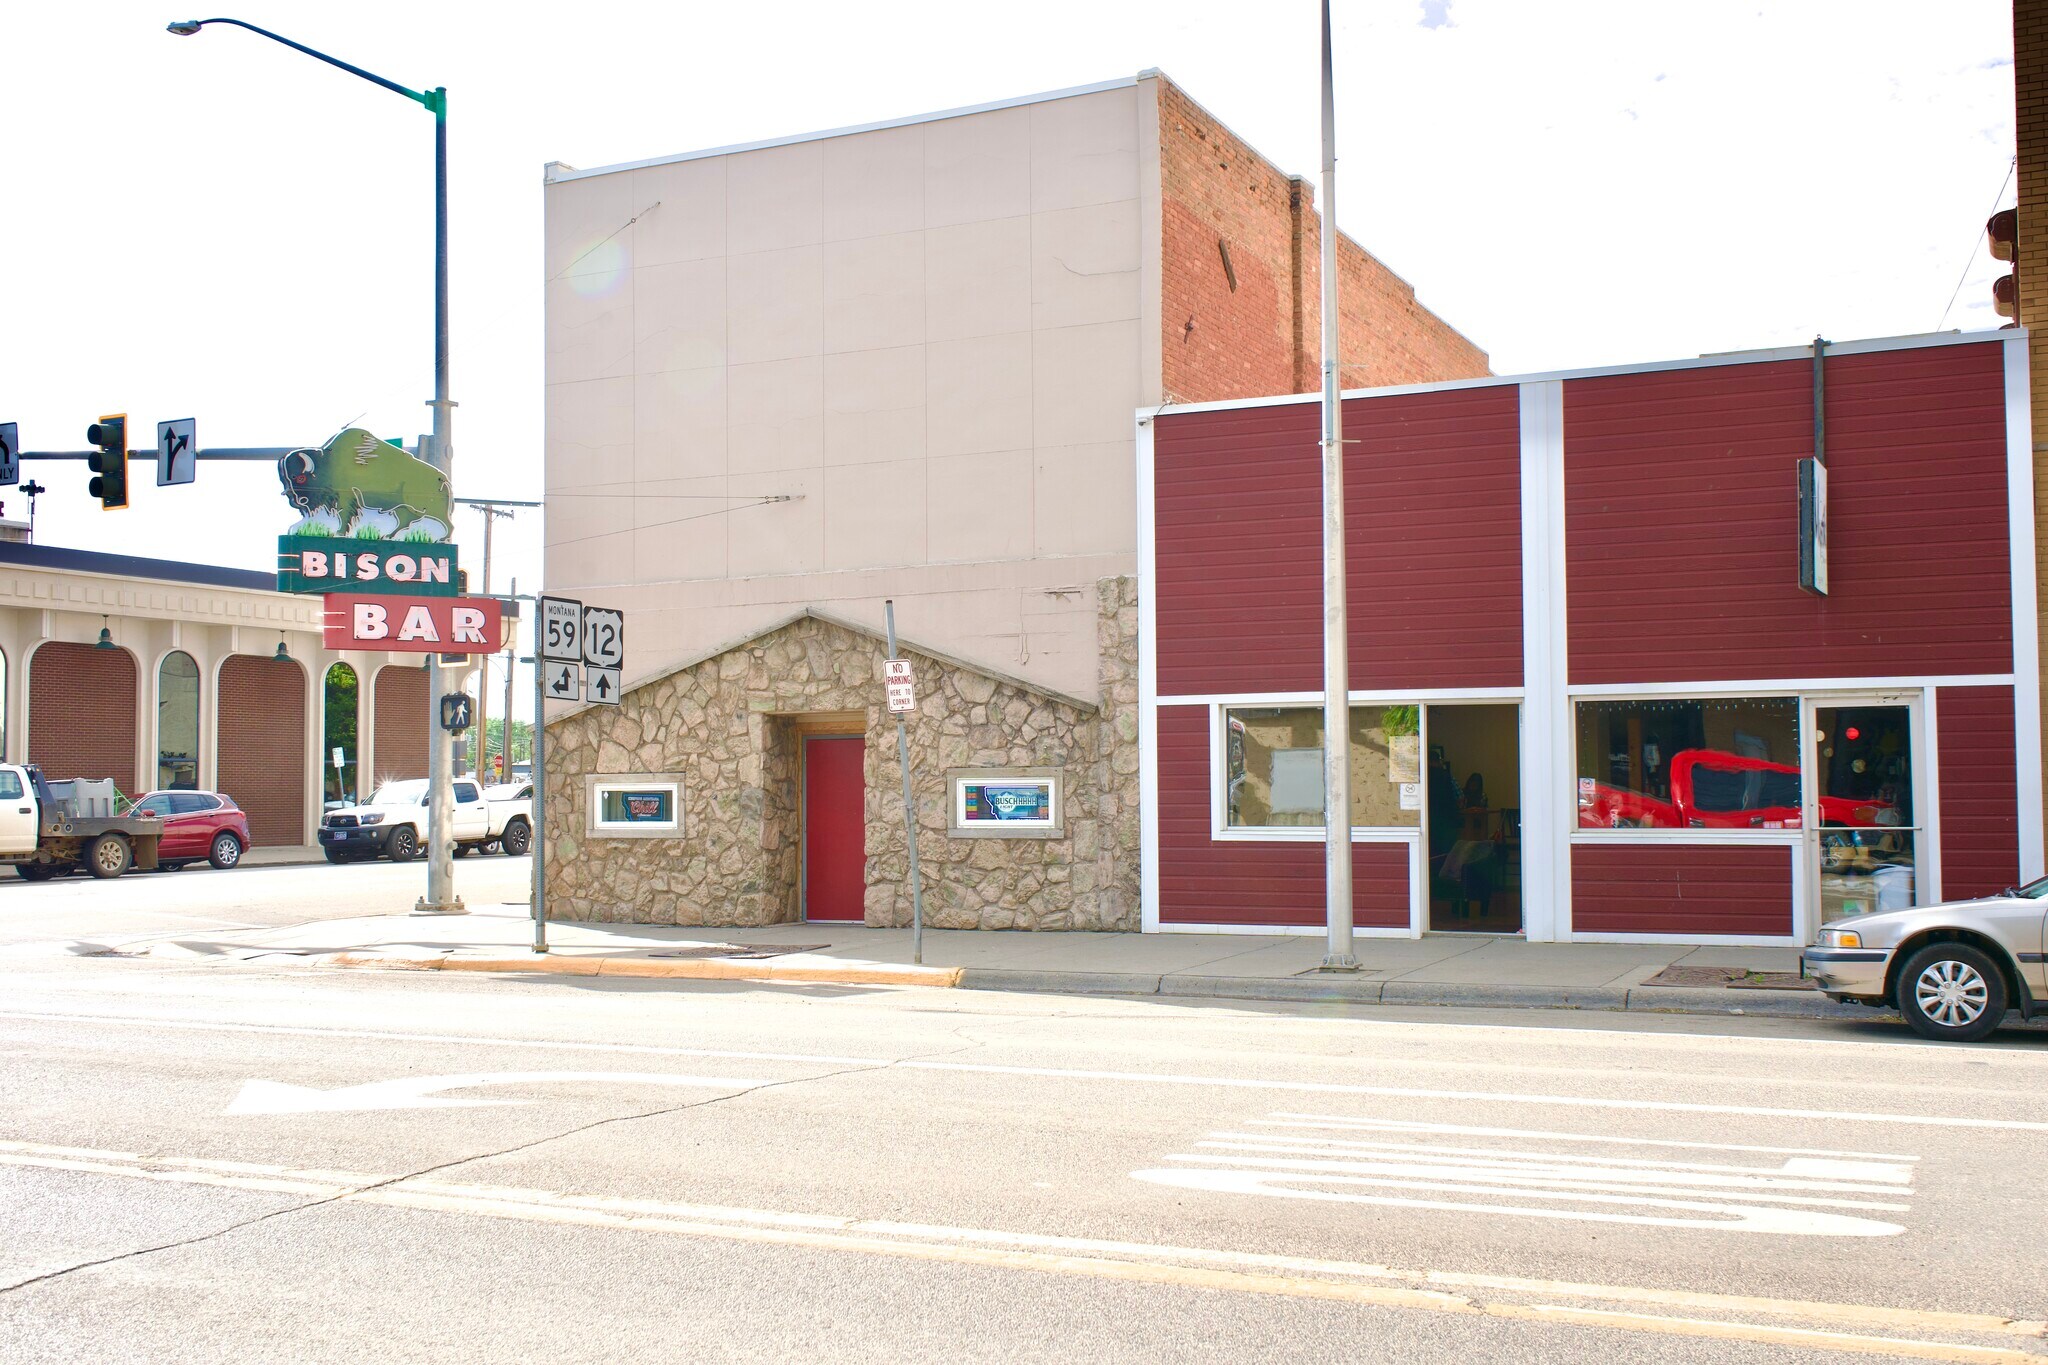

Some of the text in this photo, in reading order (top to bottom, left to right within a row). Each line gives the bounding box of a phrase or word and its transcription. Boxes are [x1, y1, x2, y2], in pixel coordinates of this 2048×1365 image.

[302, 551, 450, 583] BISON
[548, 605, 576, 617] MONTANA
[353, 602, 488, 644] BAR
[548, 619, 575, 648] 59
[592, 622, 615, 656] 12
[892, 663, 903, 674] NO
[887, 675, 911, 685] PARKING
[893, 698, 910, 706] CORNER
